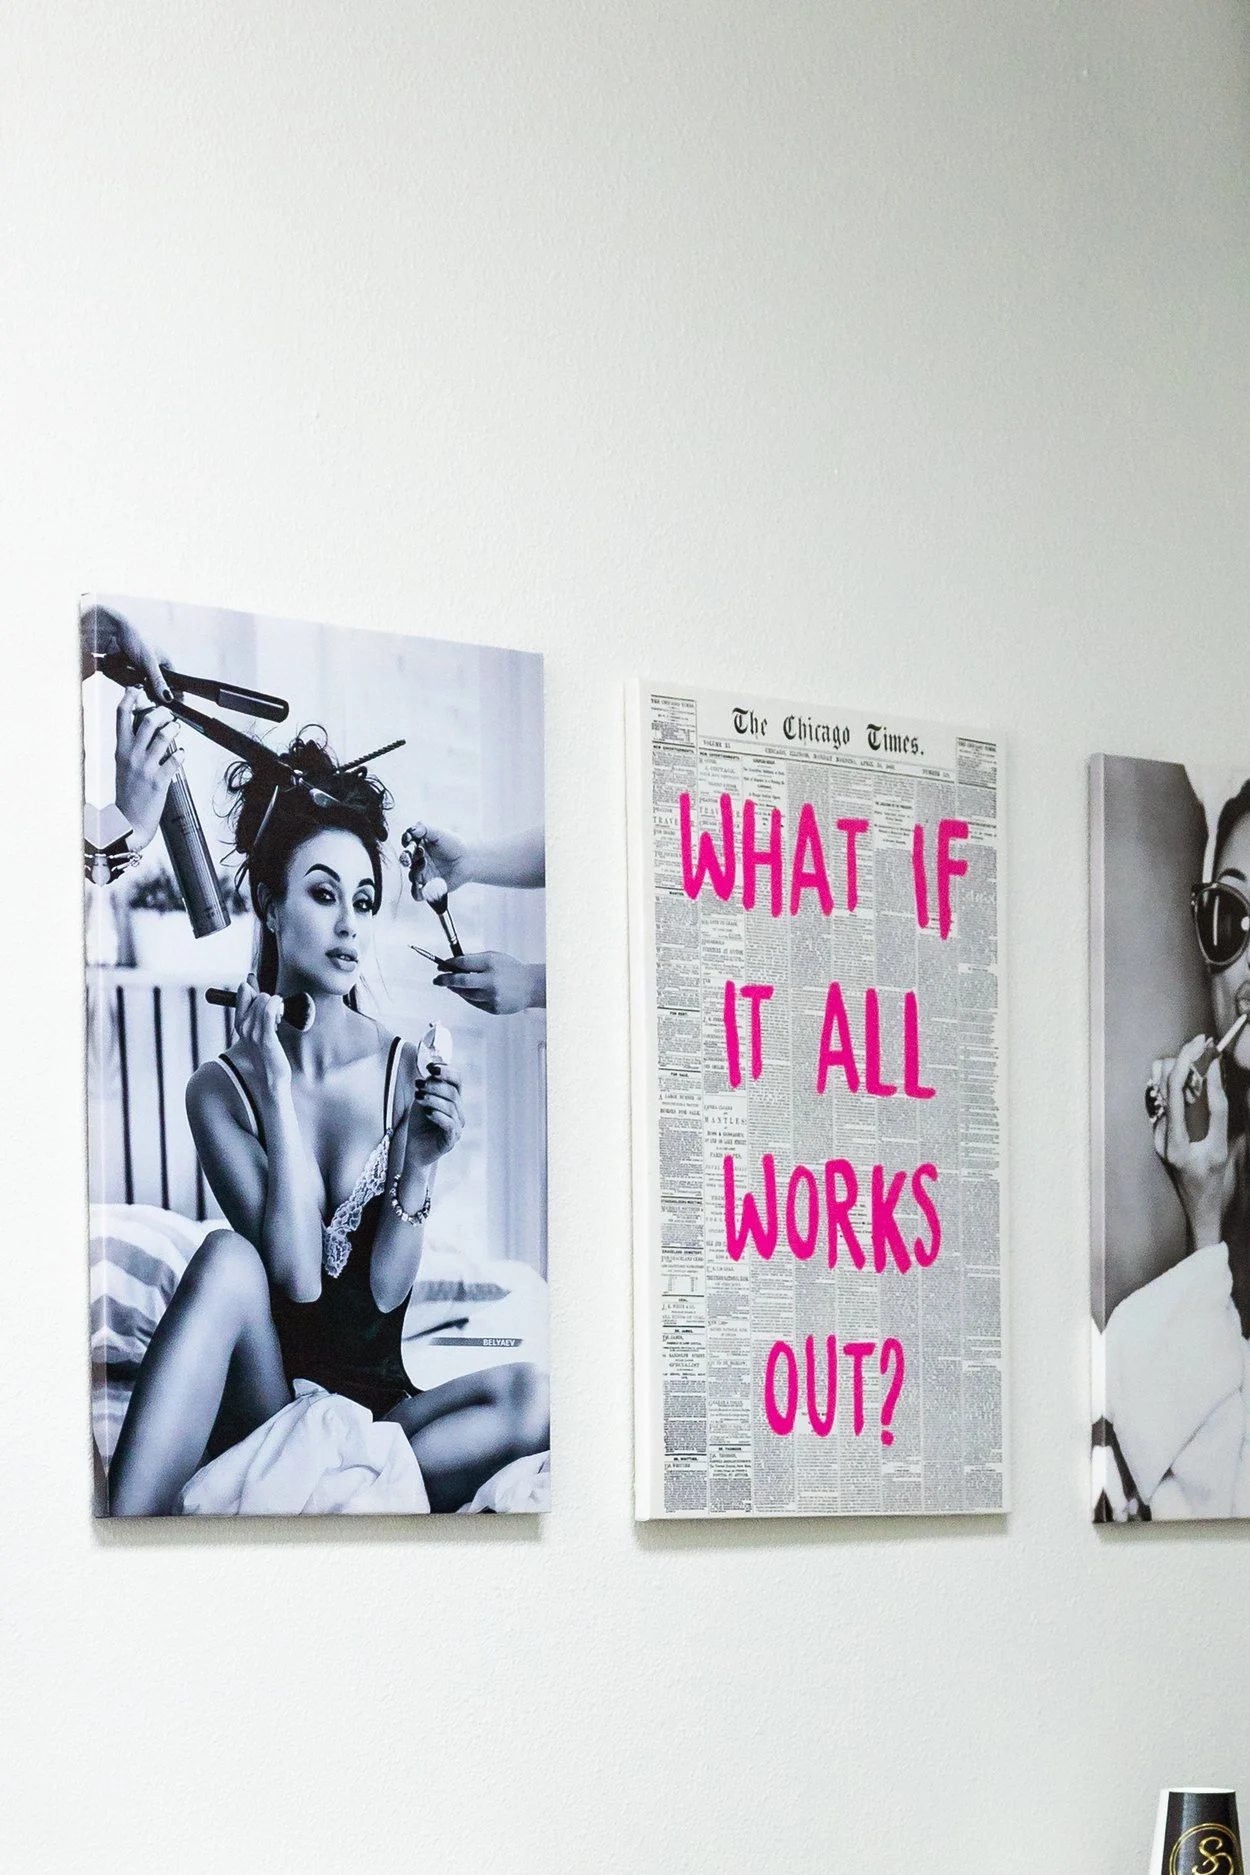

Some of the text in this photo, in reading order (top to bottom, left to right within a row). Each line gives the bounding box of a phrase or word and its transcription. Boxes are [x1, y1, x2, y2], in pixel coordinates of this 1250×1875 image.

[732, 707, 768, 738] The
[783, 715, 850, 750] Chicago
[866, 723, 924, 756] Times.
[680, 794, 868, 917] WHAT
[913, 820, 968, 940] IF
[724, 981, 773, 1088] IT
[817, 983, 935, 1098] ALL
[724, 1154, 941, 1273] WORKS
[483, 1338, 515, 1347] BELYAEV
[765, 1335, 904, 1445] OUT?
